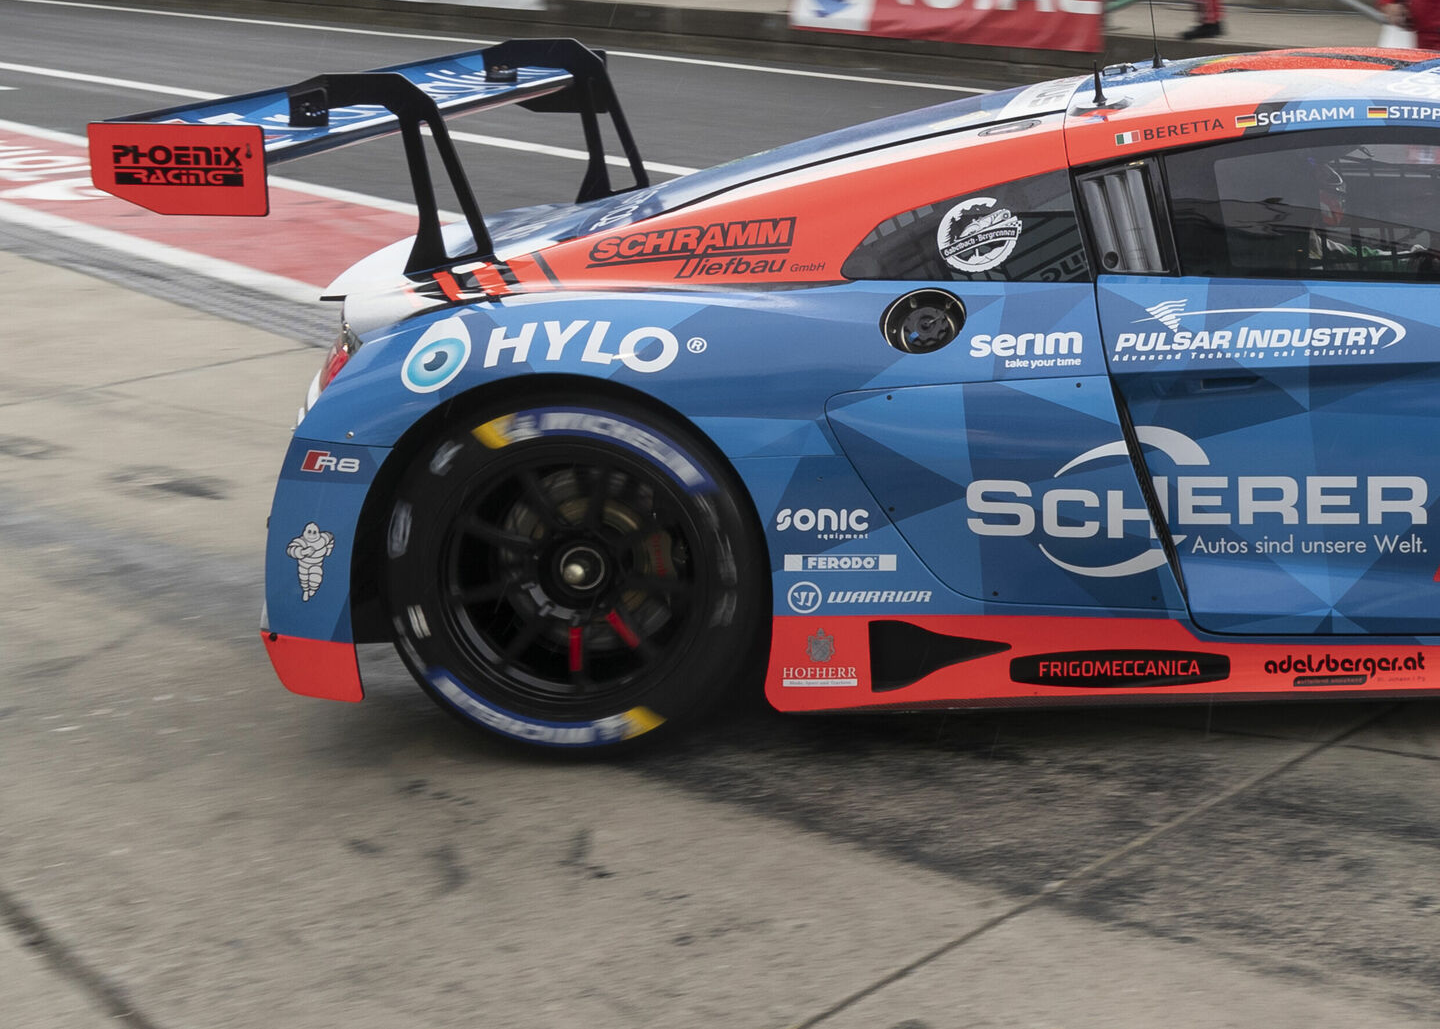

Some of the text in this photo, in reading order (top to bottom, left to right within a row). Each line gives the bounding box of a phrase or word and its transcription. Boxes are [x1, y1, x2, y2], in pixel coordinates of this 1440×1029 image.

[1258, 107, 1355, 126] SCHRAMM
[1143, 118, 1224, 141] BERETTA
[588, 216, 797, 263] SCHRAMM
[675, 257, 826, 279] Tiefbau GmbH
[483, 320, 680, 373] HYLO
[1115, 326, 1388, 352] PULSAR INDUSTRY
[1304, 347, 1375, 357] Solutions
[1005, 358, 1082, 369] take your time
[313, 456, 361, 473] R8
[966, 474, 1428, 538] SCHERER
[817, 533, 869, 541] equipment
[1191, 533, 1429, 554] Autos sind unsere Welt.
[807, 557, 876, 569] FERODO
[827, 590, 933, 603] WARRIOR
[783, 666, 857, 678] HOFHERR
[1039, 659, 1201, 677] FRIGOMECCANICA
[1264, 652, 1425, 678] adelsberger.at
